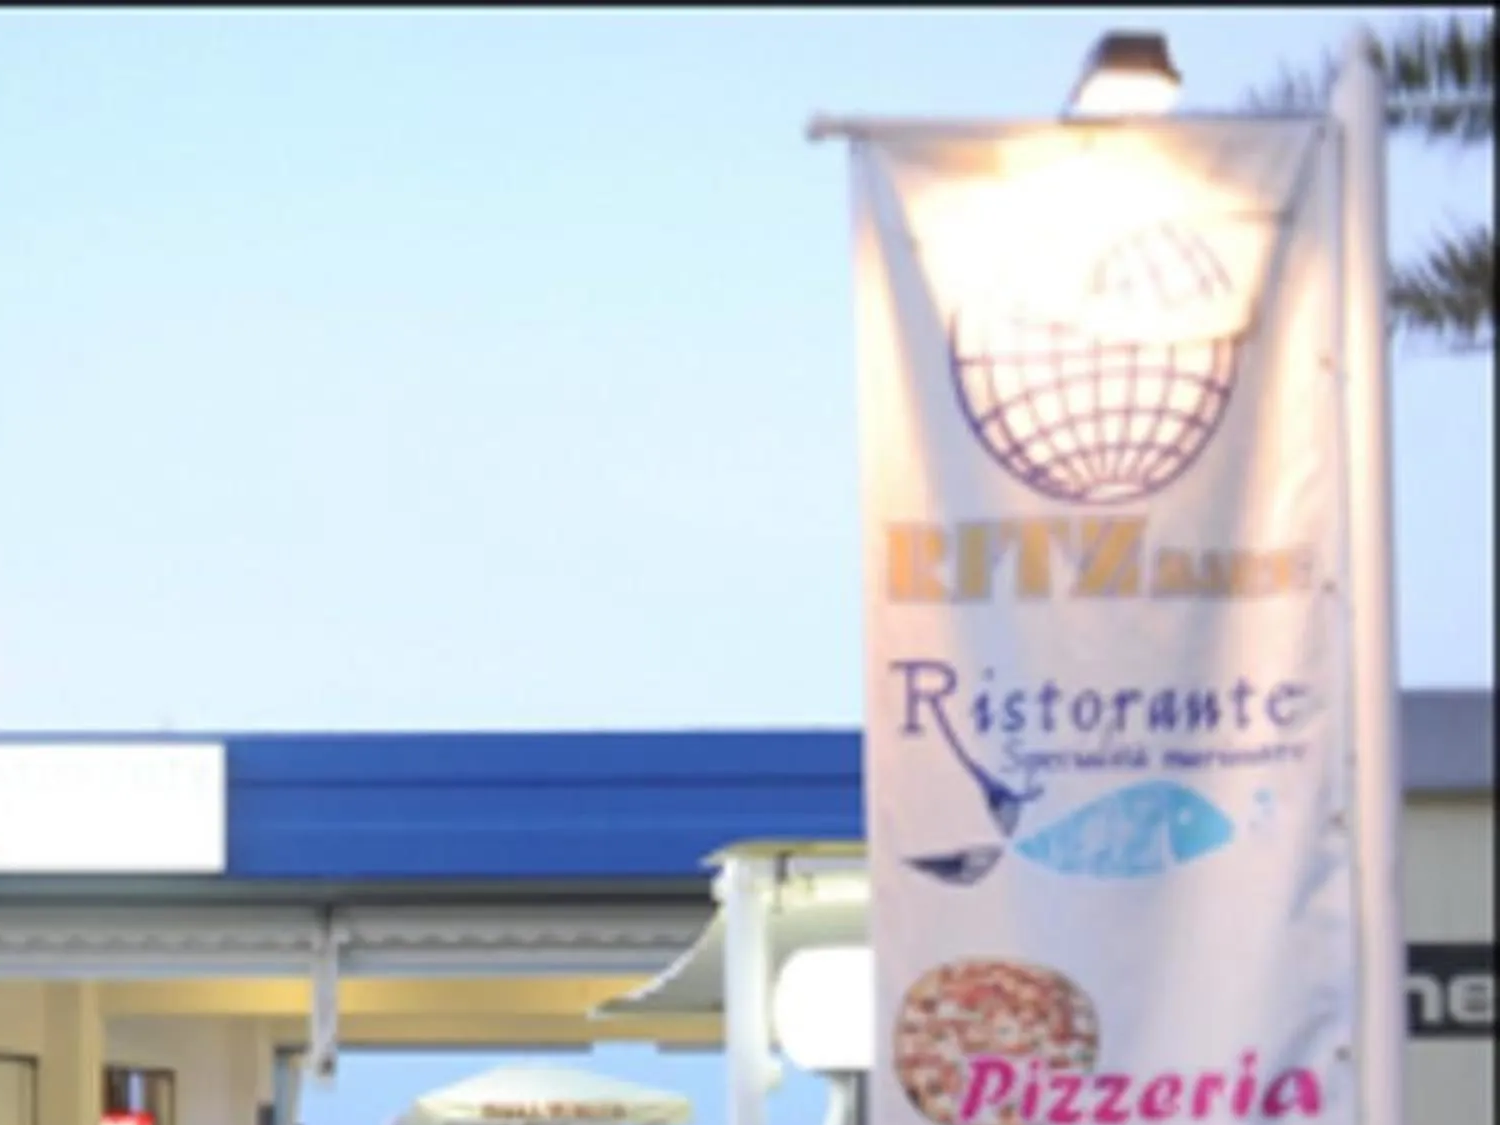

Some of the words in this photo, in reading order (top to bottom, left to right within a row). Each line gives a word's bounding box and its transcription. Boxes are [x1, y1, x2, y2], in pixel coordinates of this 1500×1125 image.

[887, 515, 1146, 602] RITZ
[888, 659, 1310, 765] Ristorante
[959, 1047, 1324, 1125] Pizzeria
